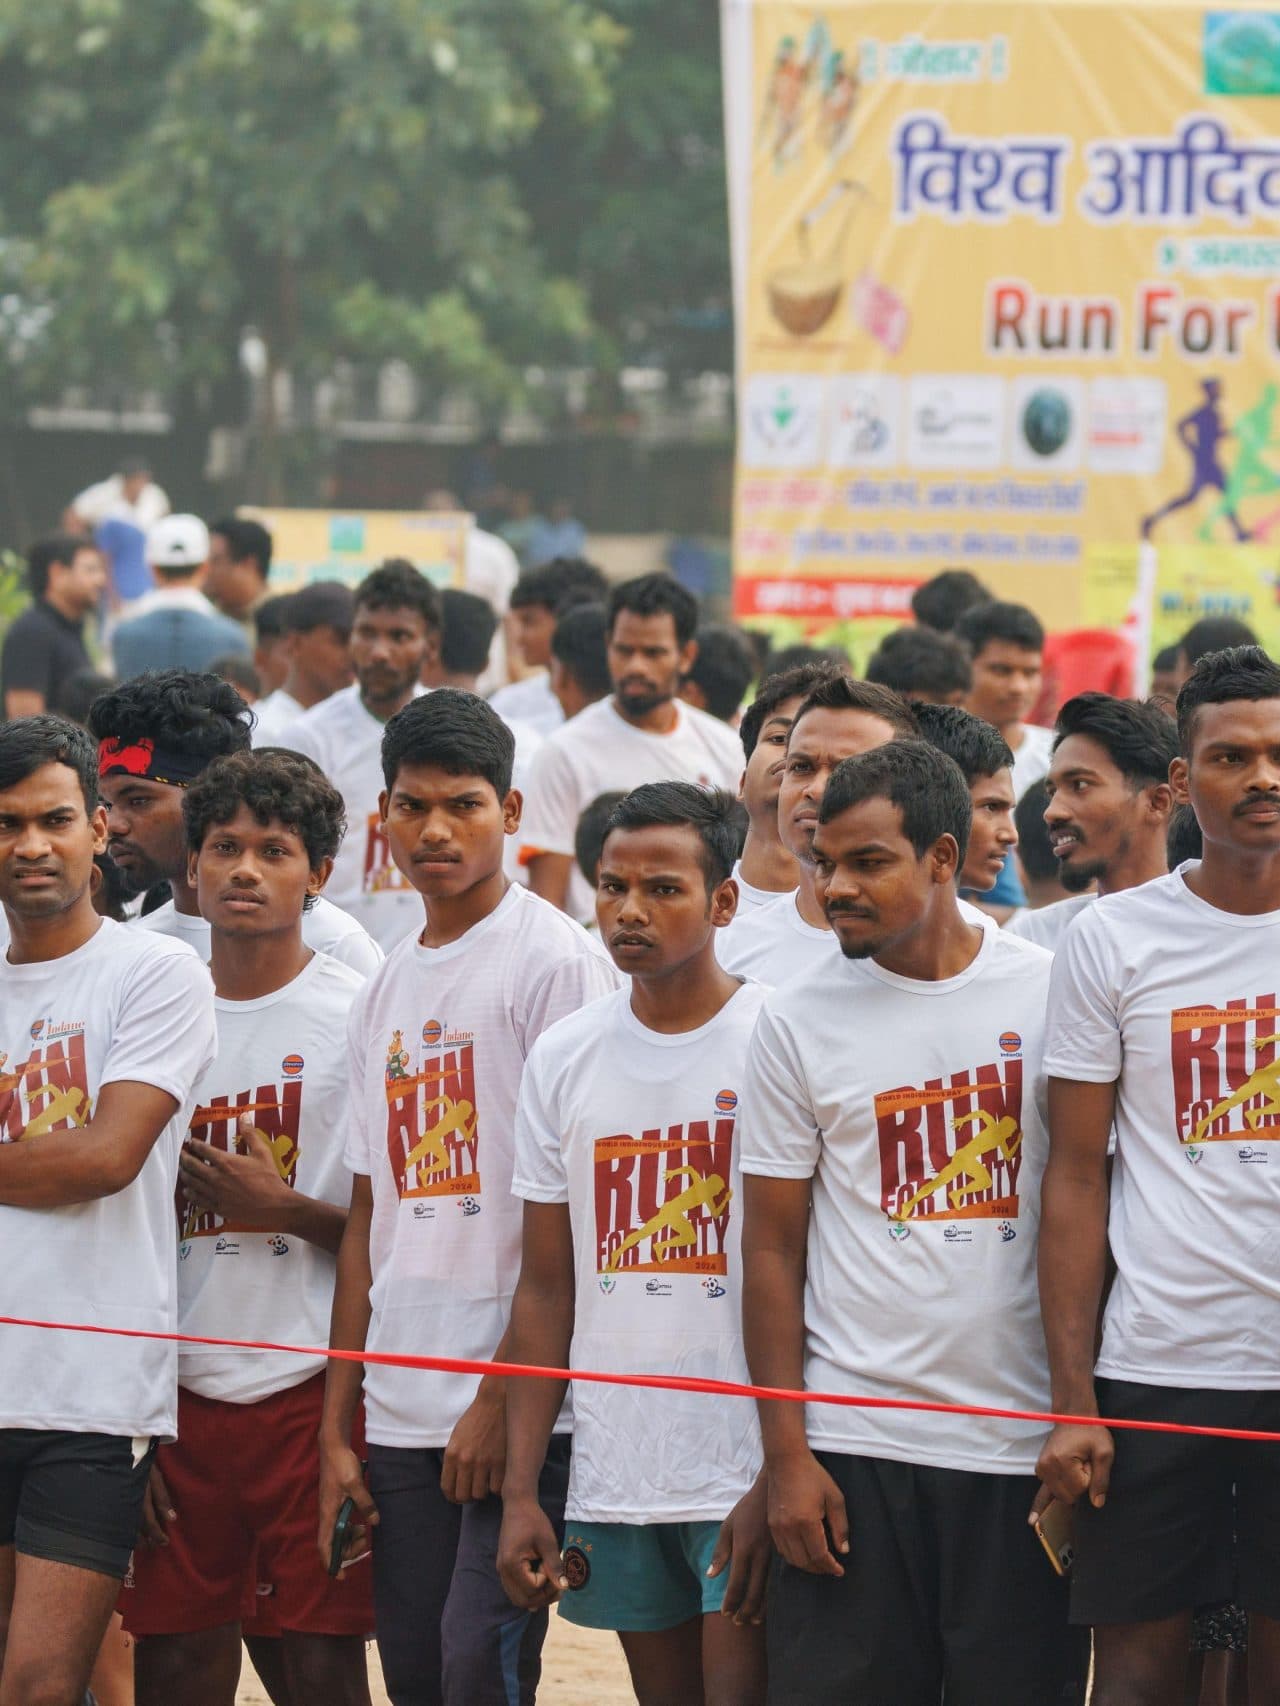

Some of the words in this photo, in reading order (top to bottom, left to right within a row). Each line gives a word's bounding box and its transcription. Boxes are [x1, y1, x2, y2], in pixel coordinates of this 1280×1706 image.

[896, 119, 1064, 214] विश्व
[992, 288, 1116, 352] Run
[1140, 288, 1250, 355] For
[874, 1059, 1023, 1184] RUN
[948, 1089, 962, 1097] DAY
[1176, 1096, 1231, 1144] FOR
[594, 1119, 735, 1235] RUN
